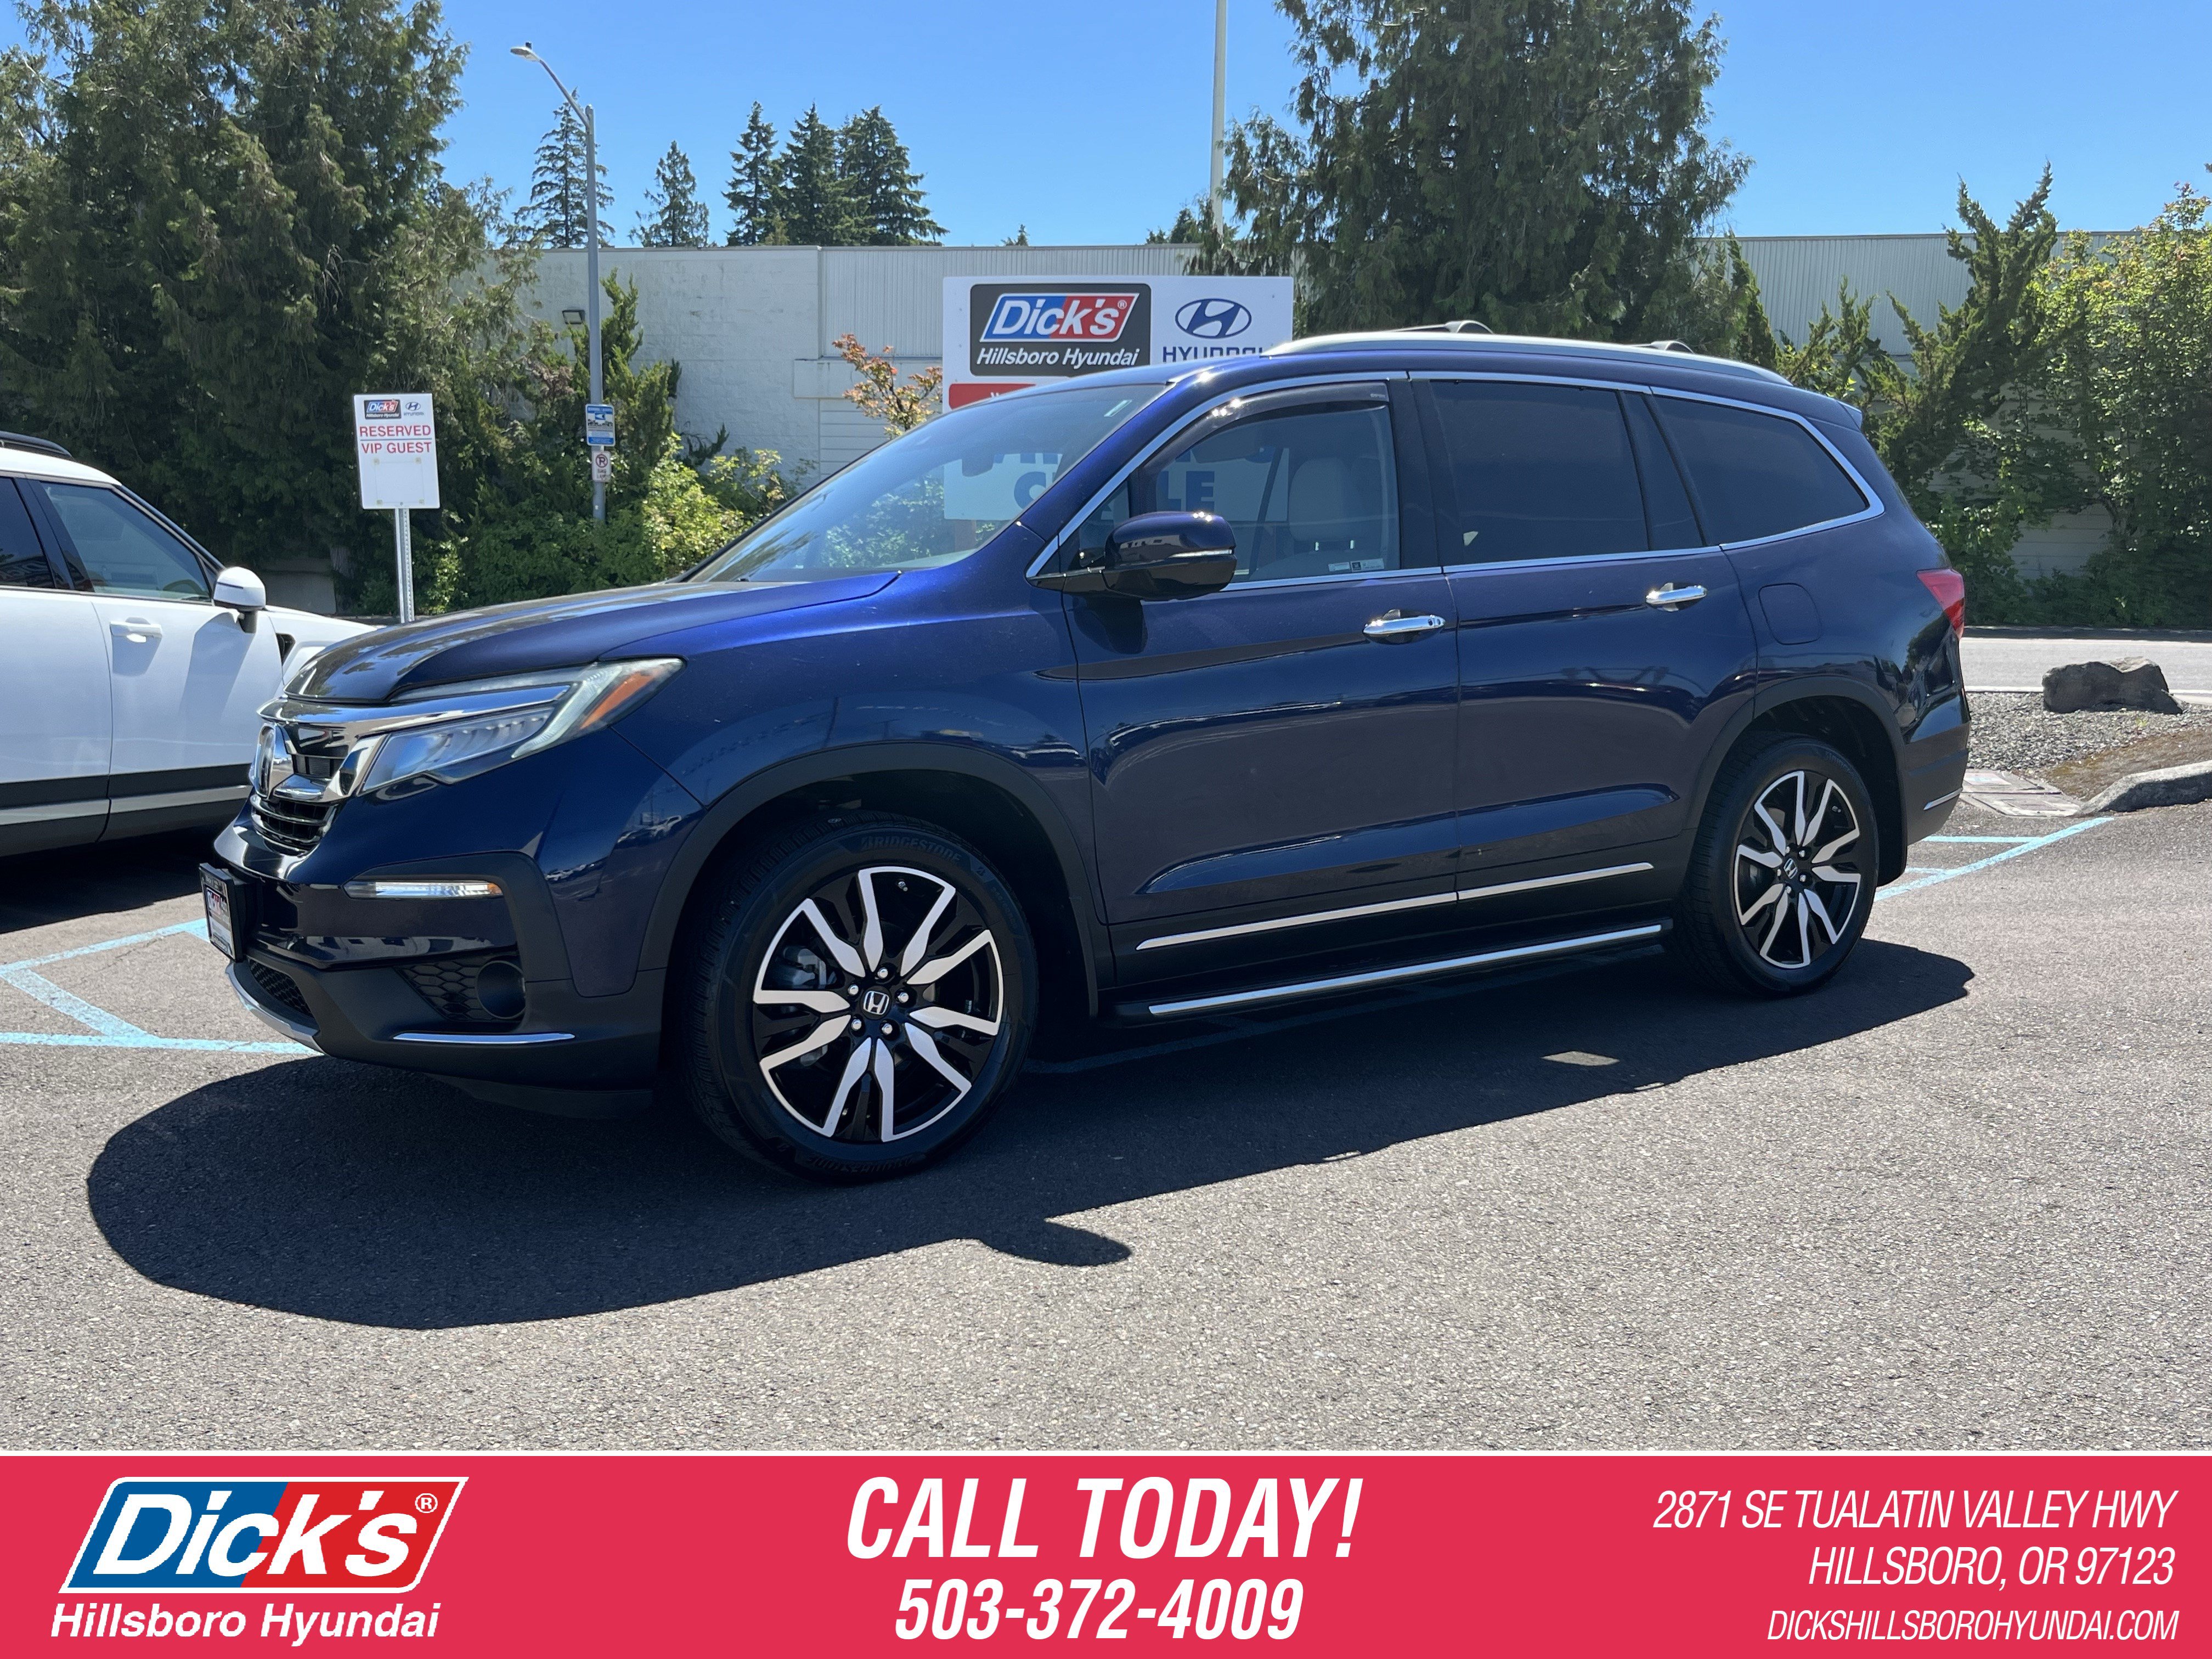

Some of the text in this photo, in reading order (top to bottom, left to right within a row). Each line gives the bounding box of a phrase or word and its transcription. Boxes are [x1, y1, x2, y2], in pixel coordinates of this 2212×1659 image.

[976, 347, 1141, 370] Hillsboro Hyundai
[359, 425, 431, 437] RESERVED
[361, 442, 432, 454] VIP GUEST
